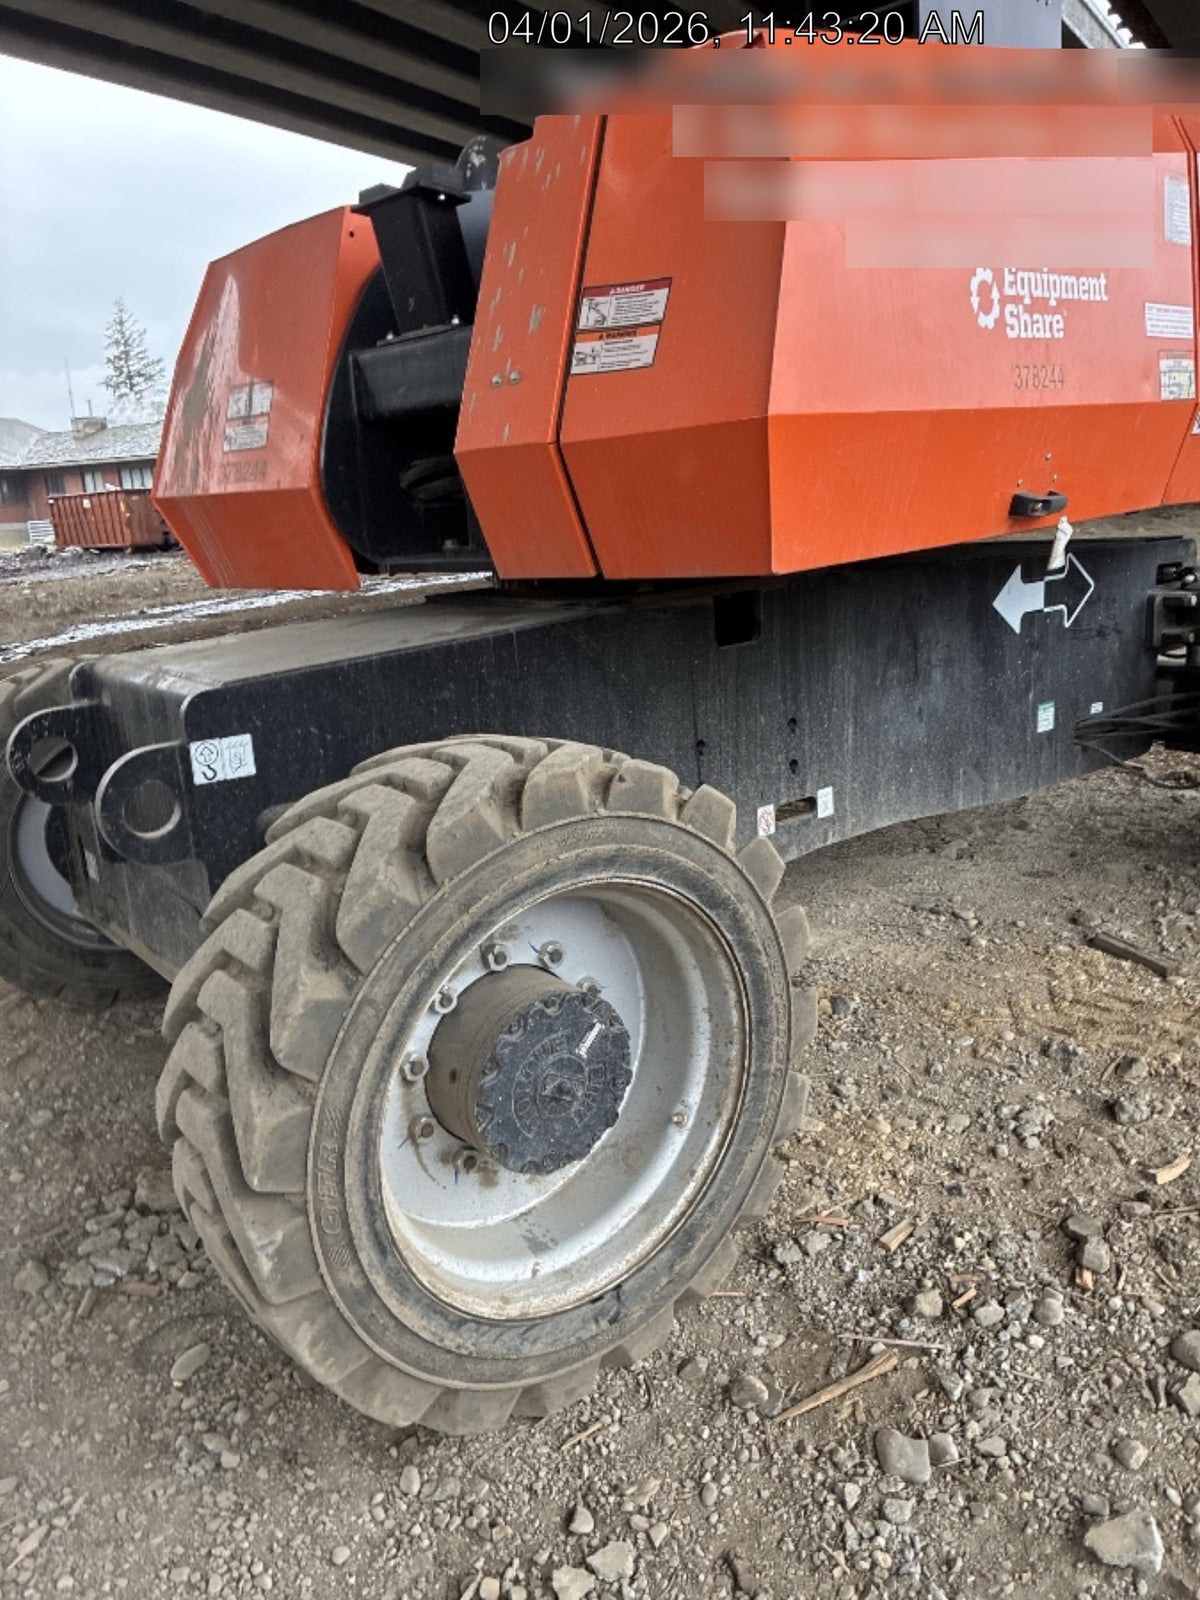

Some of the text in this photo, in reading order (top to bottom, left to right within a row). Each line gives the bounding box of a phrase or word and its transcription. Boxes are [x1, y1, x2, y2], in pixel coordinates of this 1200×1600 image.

[1003, 267, 1108, 306] Equipment
[1004, 303, 1064, 339] Share
[1014, 364, 1065, 389] 378244
